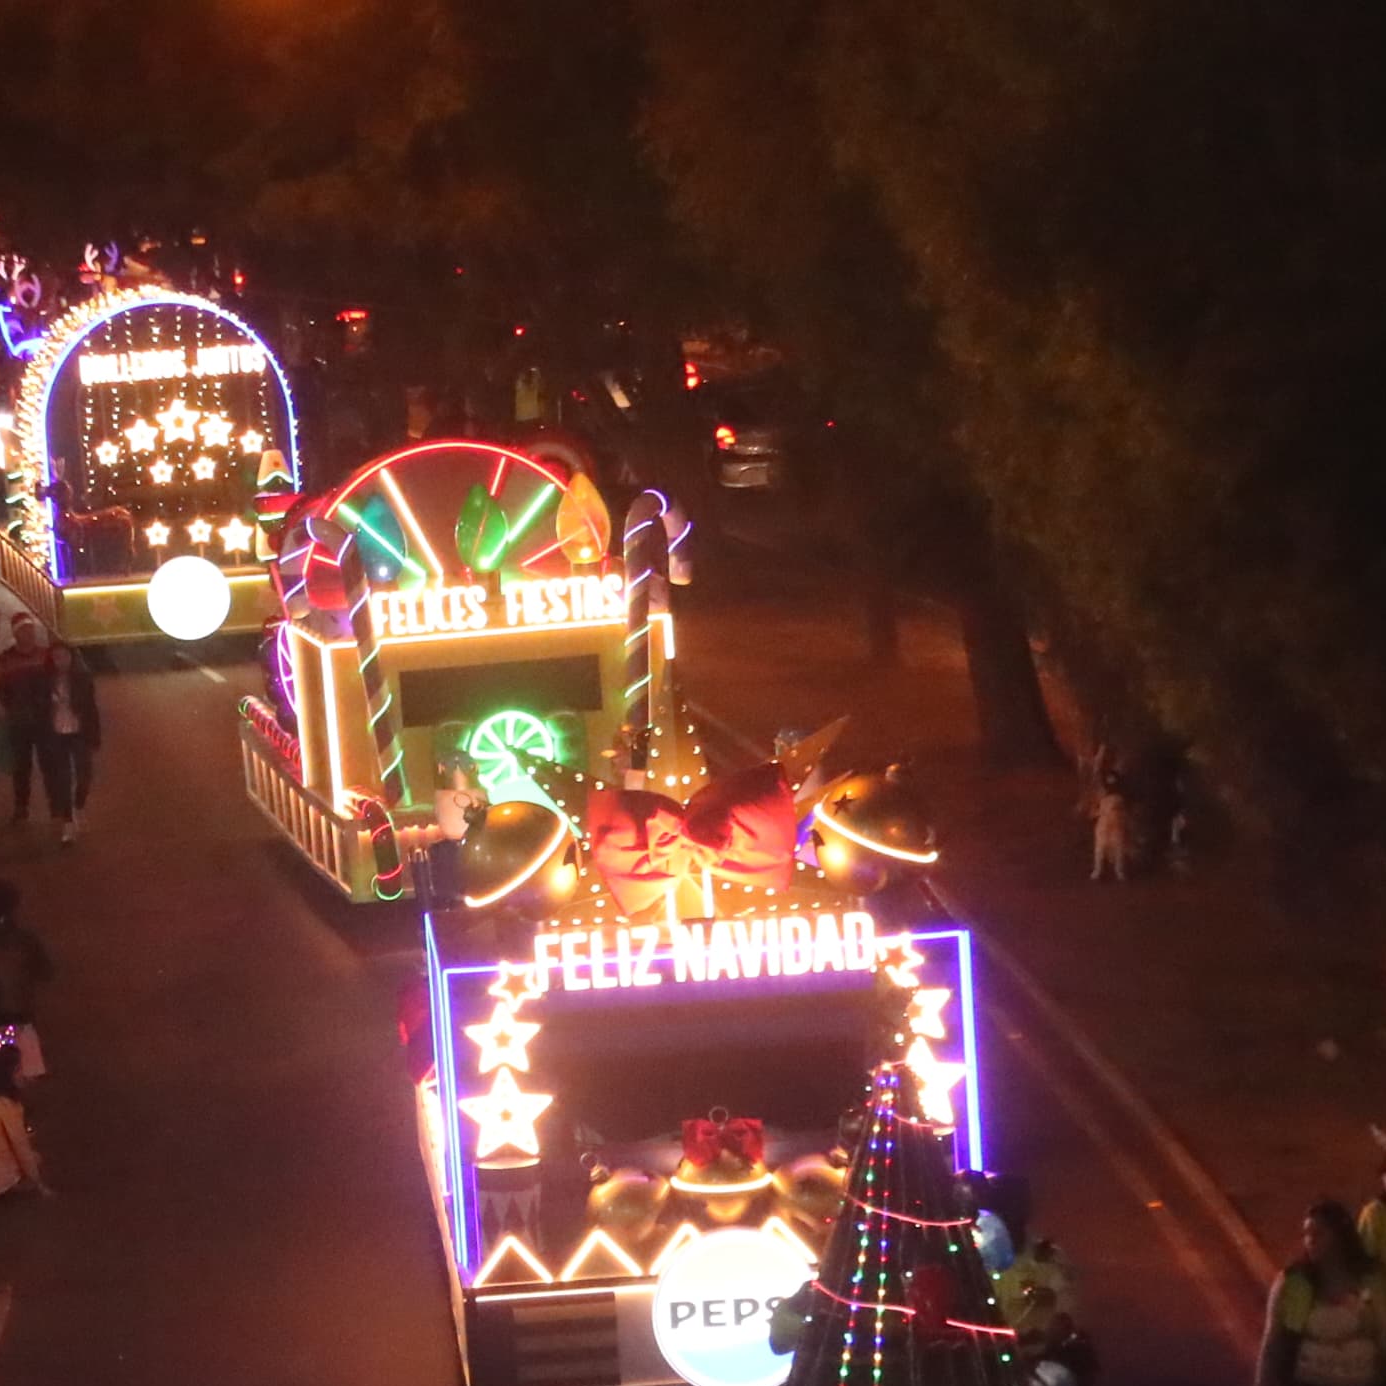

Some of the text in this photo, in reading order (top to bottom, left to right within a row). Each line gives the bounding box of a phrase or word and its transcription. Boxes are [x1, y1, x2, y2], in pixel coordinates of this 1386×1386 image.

[370, 573, 624, 637] FELICES FIESTAS
[533, 911, 876, 993] FELIZ NAVIDAD
[669, 1296, 787, 1330] PEPS
